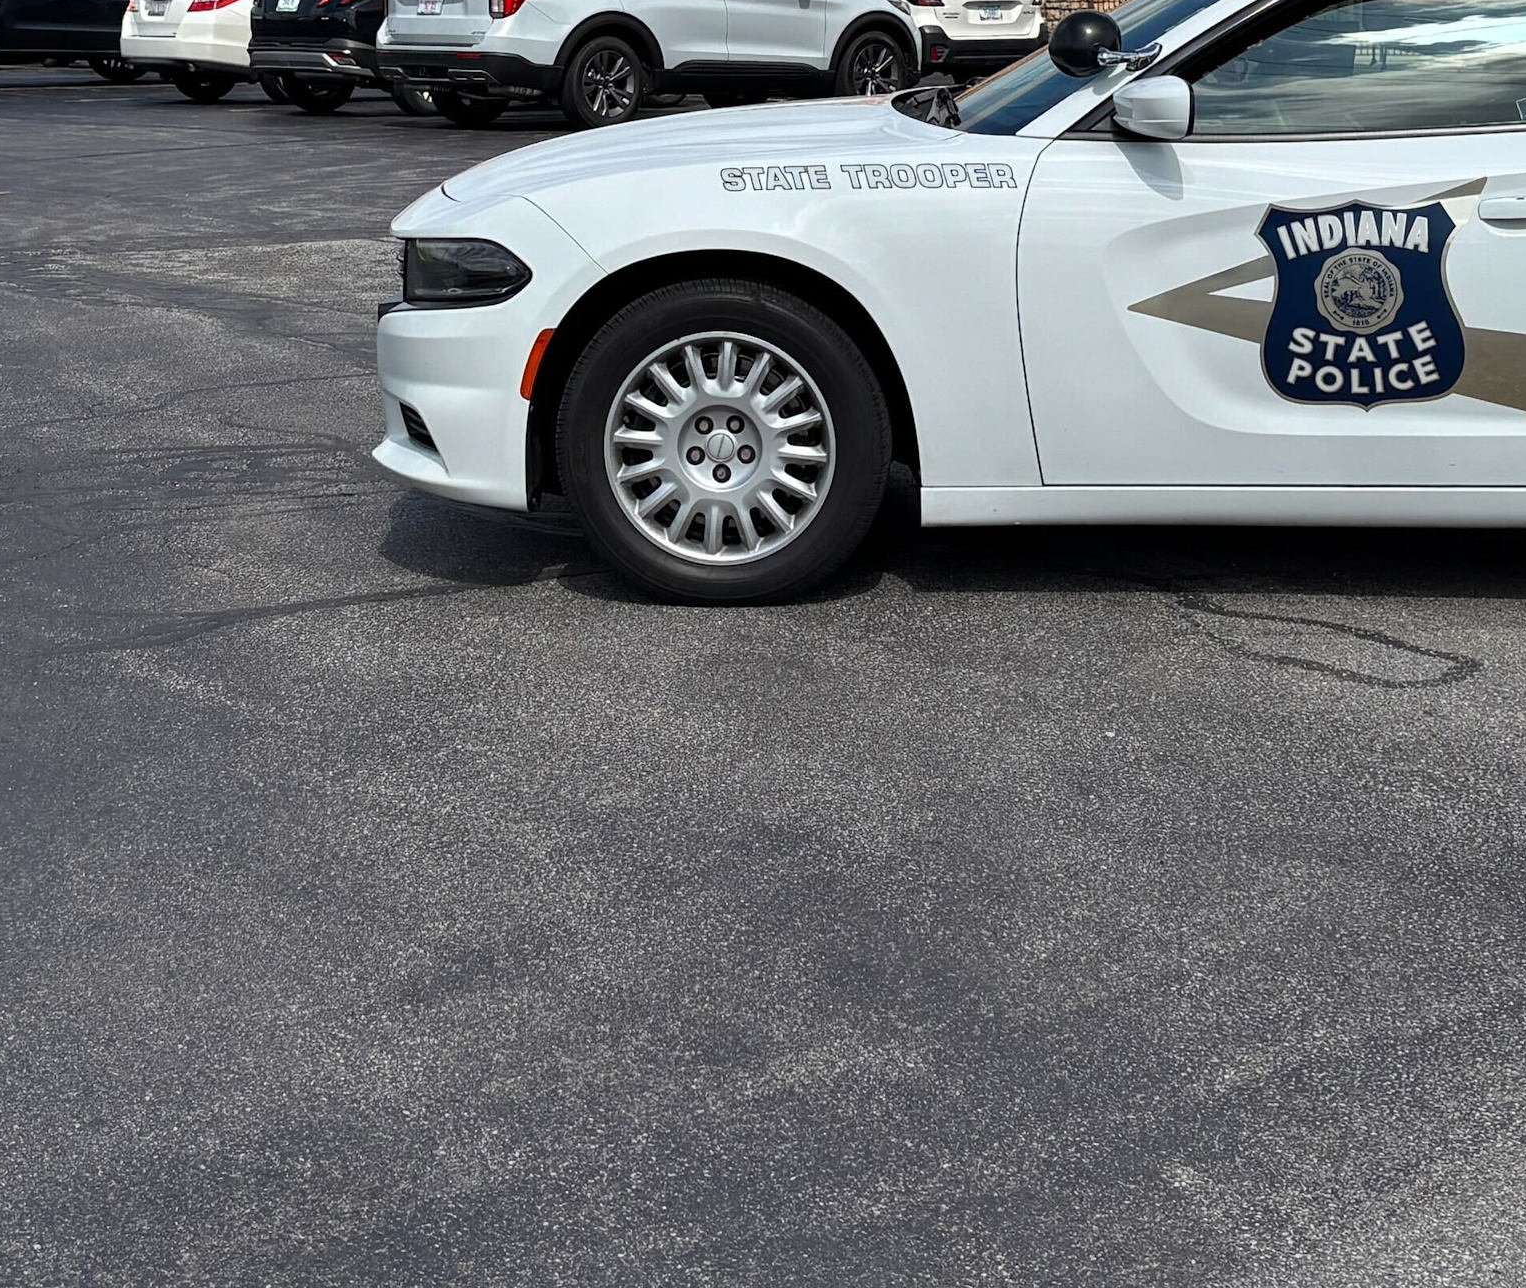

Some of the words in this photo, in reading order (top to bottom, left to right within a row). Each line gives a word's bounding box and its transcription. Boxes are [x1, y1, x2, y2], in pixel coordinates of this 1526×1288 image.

[720, 165, 832, 192] STATE
[840, 163, 1018, 190] TROOPER
[1277, 210, 1429, 261] INDIANA
[1288, 320, 1437, 363] STATE
[1286, 357, 1441, 395] POLICE
